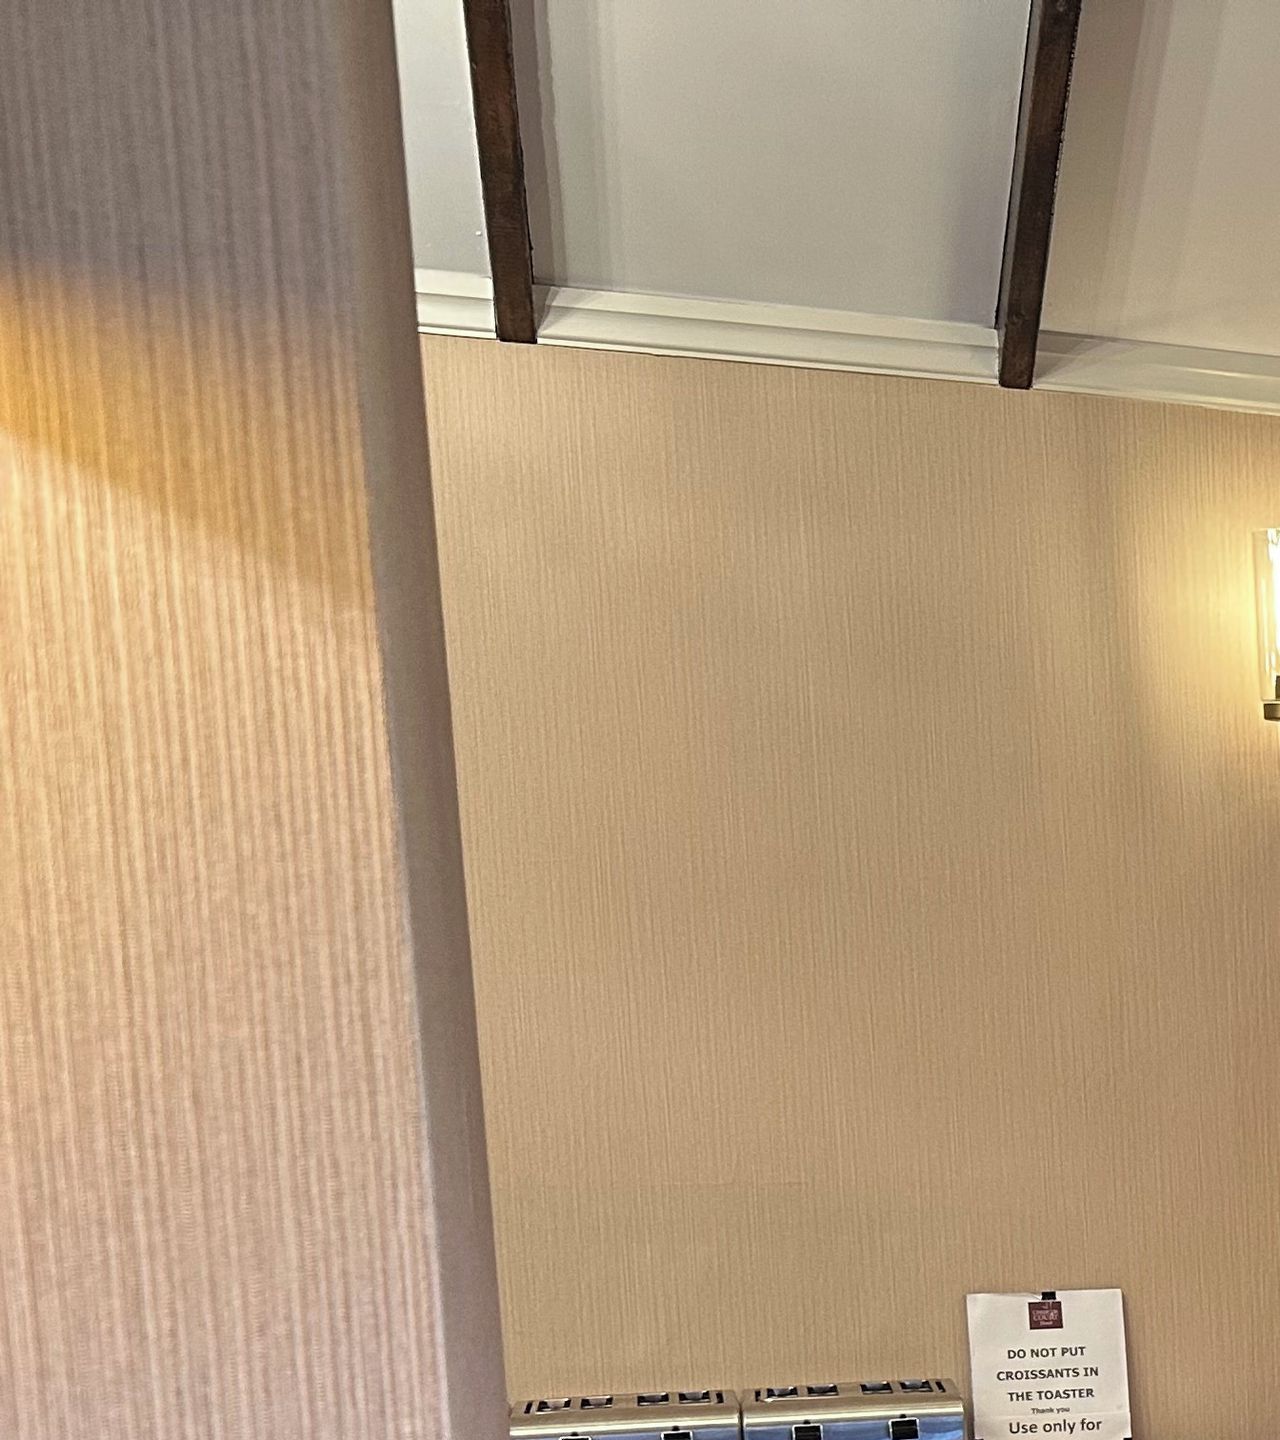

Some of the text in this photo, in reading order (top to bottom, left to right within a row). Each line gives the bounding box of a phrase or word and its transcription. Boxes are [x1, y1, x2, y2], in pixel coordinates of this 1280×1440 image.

[1007, 1346, 1086, 1360] DO NOT PUT
[996, 1366, 1099, 1381] CROISSANTS IN
[1008, 1388, 1094, 1402] THE TOASTER
[1009, 1418, 1102, 1435] Use only for
